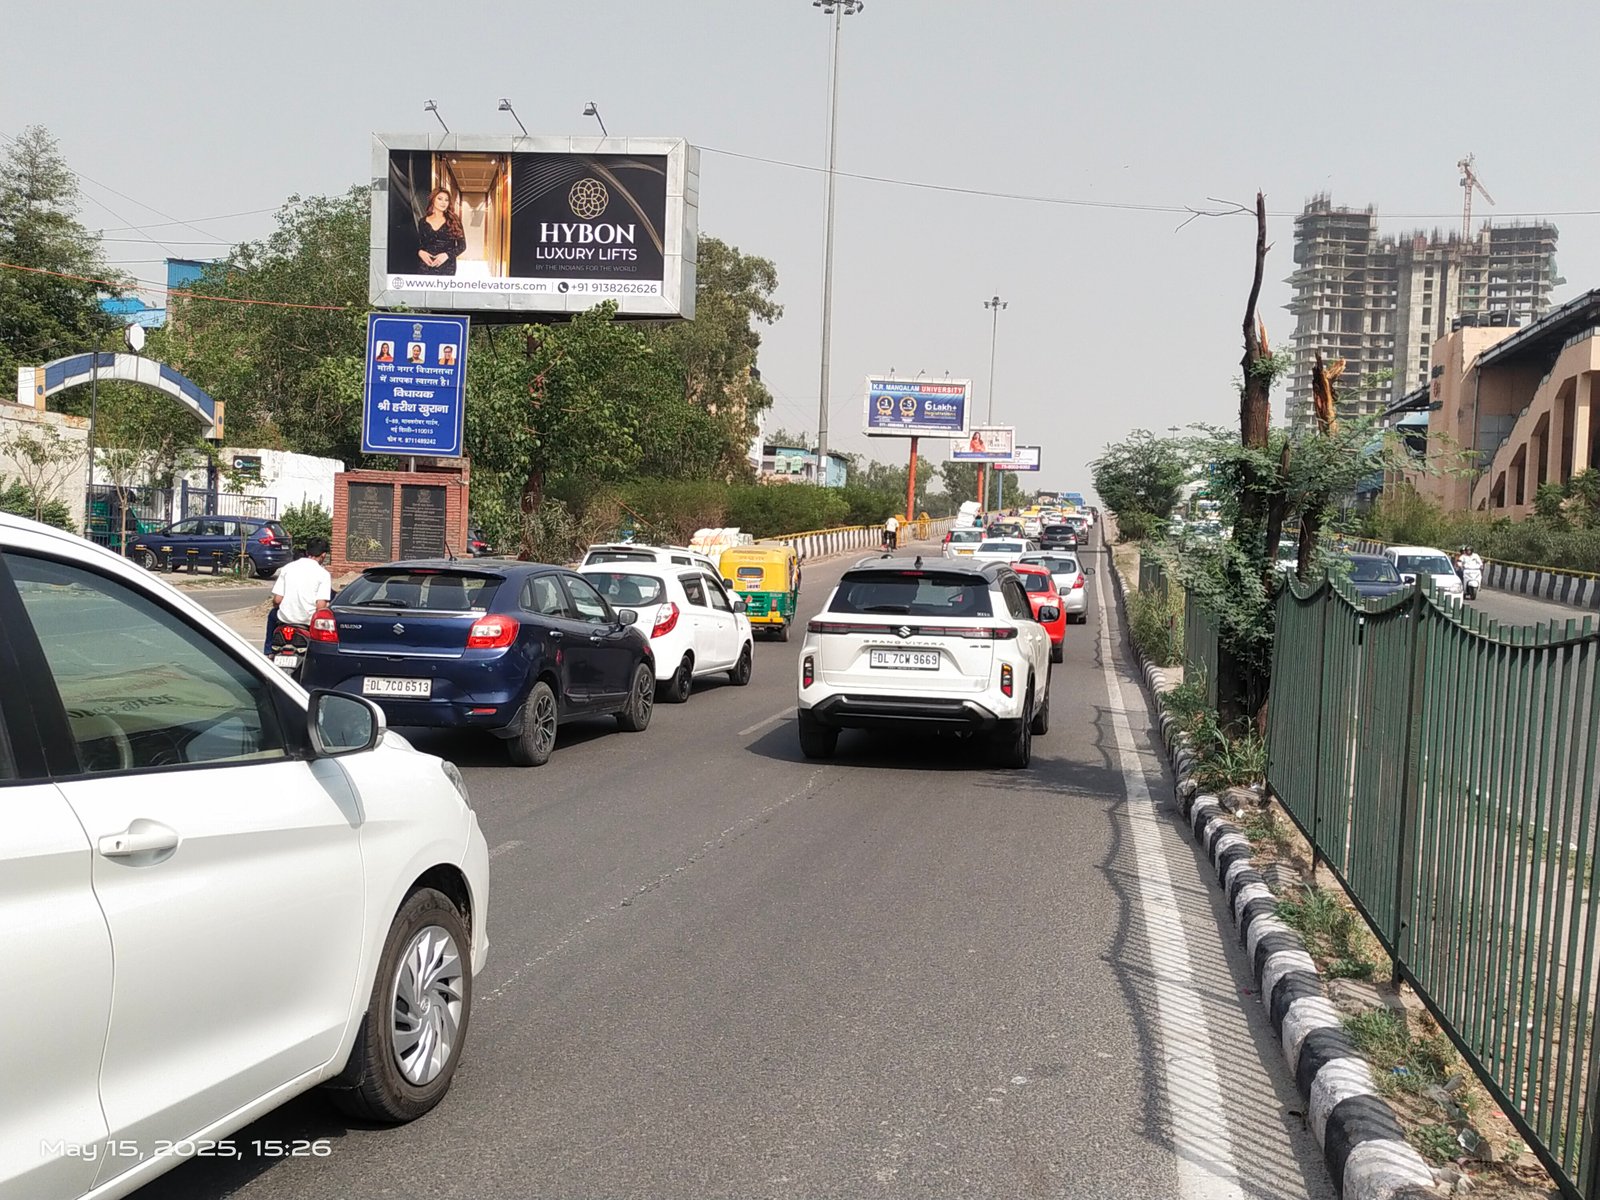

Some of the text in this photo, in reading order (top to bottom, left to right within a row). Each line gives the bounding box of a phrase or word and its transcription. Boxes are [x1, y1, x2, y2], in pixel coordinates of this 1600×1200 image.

[540, 222, 636, 244] HYBON
[536, 247, 638, 261] LUXURY LIFTS
[405, 278, 658, 294] www.hybonelevators.com +91 9138262626
[377, 364, 395, 372] मोती
[415, 377, 438, 386] स्वागत
[393, 387, 435, 398] विधायक
[921, 385, 963, 394] UNIVERSITY
[377, 399, 450, 417] श्री हरीश खुराना
[877, 653, 937, 665] DL 7CW 9669
[370, 680, 381, 691] DL
[405, 681, 429, 692] 6513
